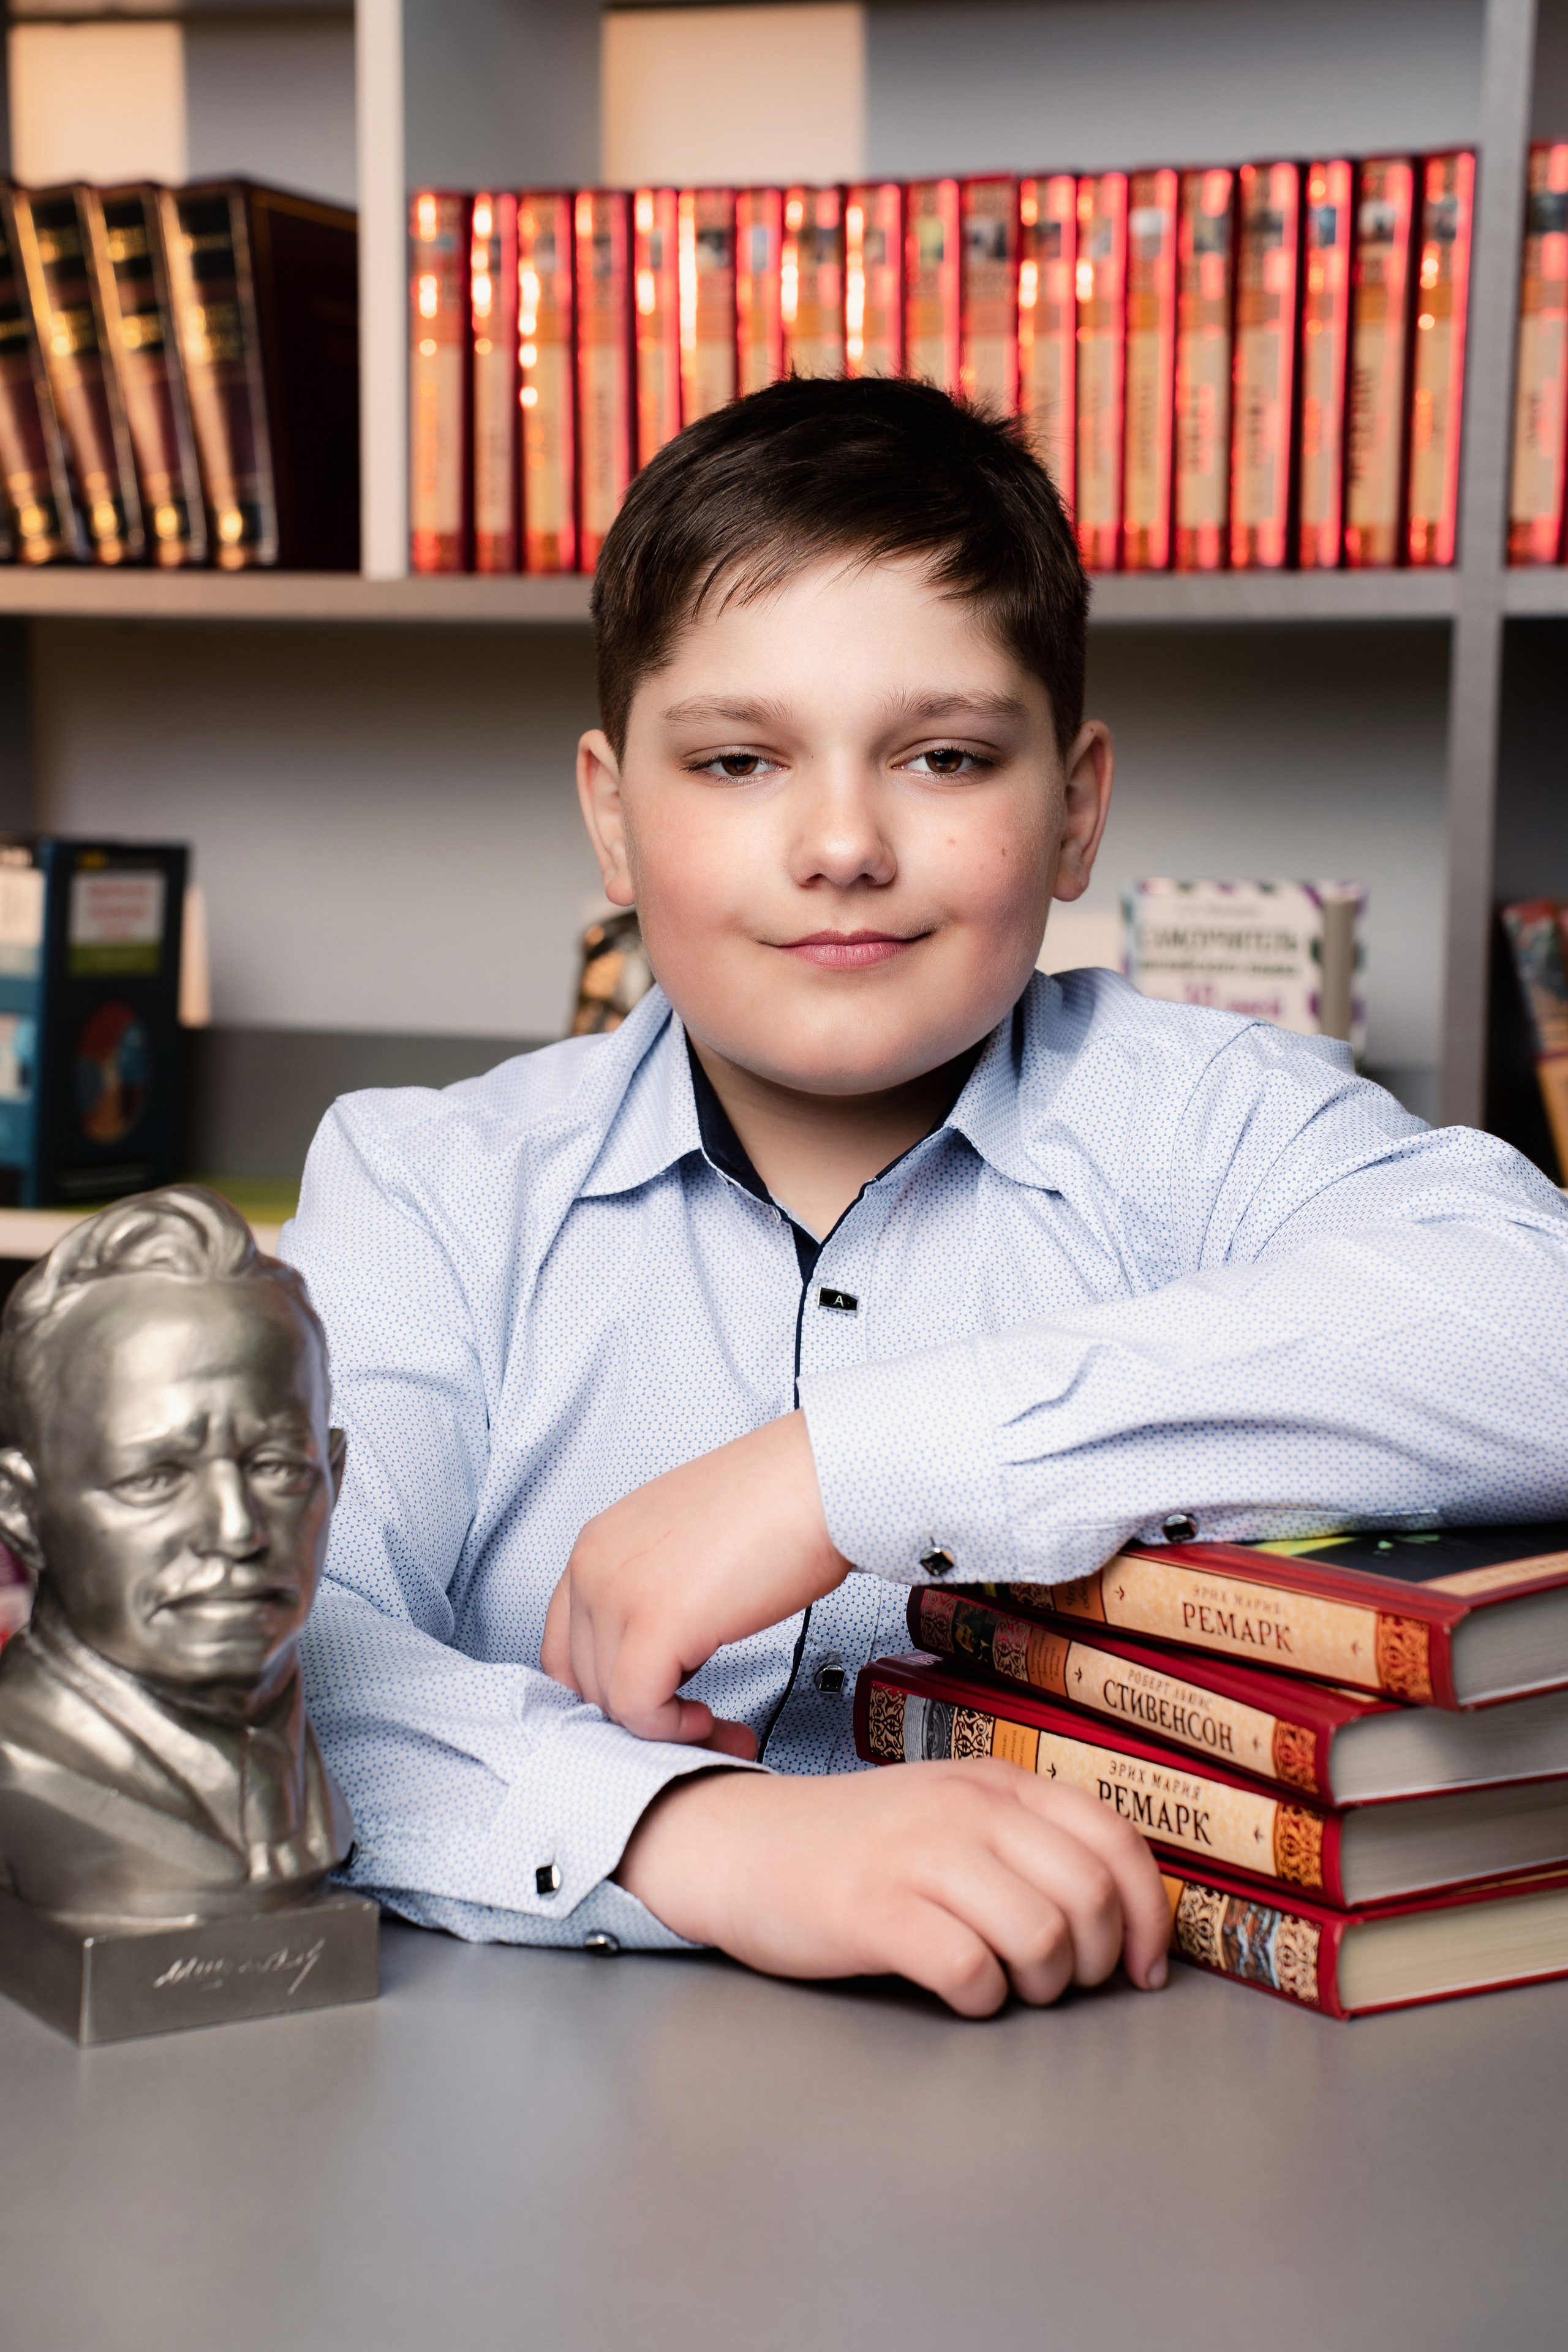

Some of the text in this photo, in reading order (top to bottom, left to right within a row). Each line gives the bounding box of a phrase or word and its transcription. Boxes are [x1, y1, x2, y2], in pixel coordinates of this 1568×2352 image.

[1183, 1602, 1293, 1653] РЕМАРК
[1128, 1668, 1170, 1695] РОБЕРТ
[1103, 1679, 1234, 1754] СТИВЕНСОН
[1109, 1760, 1202, 1801] ЭРИХ МАРИЯ
[1096, 1778, 1212, 1845] РЕМАРК
